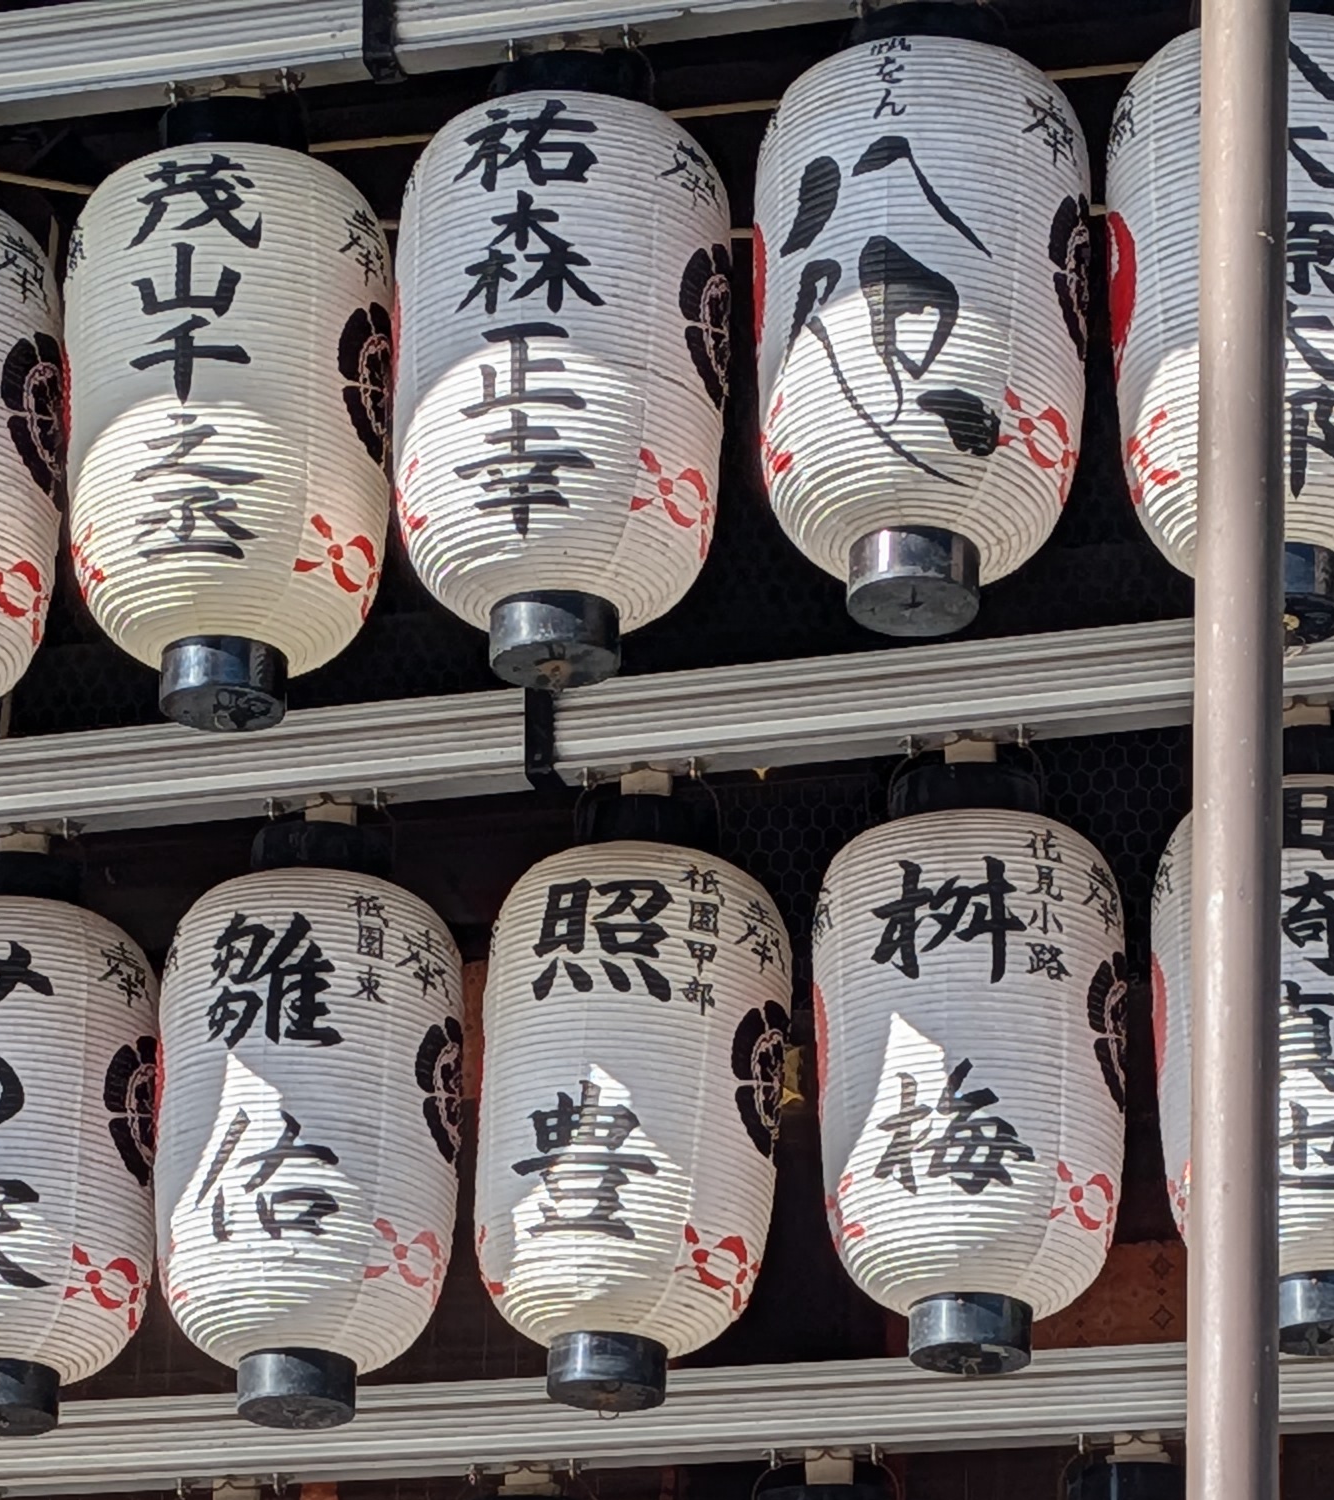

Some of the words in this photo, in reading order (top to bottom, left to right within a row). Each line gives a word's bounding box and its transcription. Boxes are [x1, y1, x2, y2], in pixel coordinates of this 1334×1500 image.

[128, 153, 267, 559] 茂山千之丞
[453, 100, 606, 538] 祐森正幸
[512, 878, 673, 1240] 照豊
[1025, 829, 1072, 981] 花見小路
